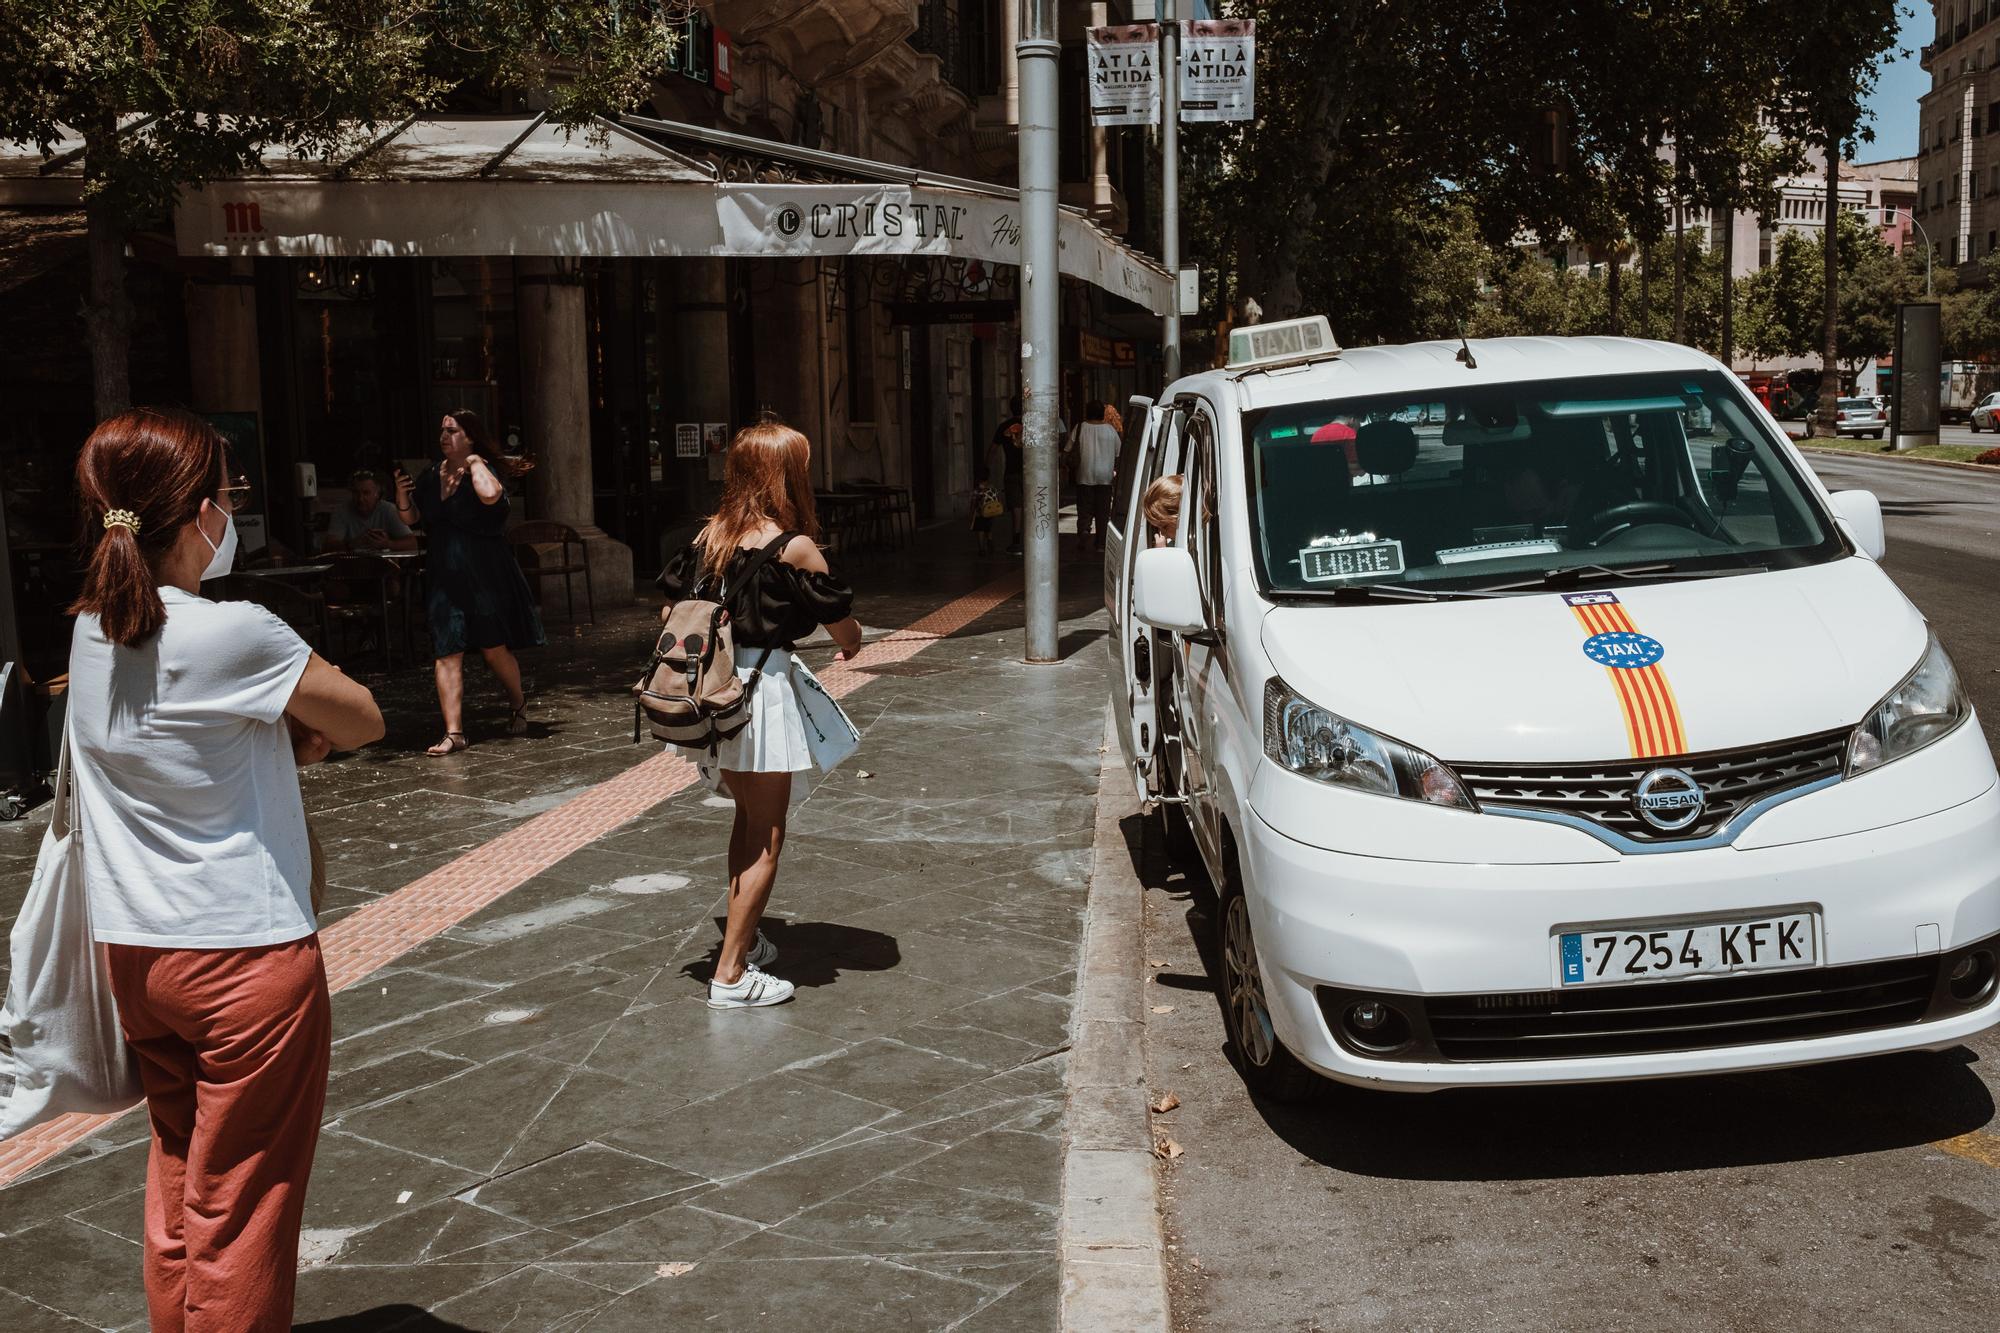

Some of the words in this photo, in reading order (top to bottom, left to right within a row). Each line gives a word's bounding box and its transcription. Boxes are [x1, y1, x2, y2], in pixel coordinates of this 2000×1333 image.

[1096, 70, 1153, 84] NTIDA
[1188, 64, 1247, 78] NTIDA
[1253, 326, 1300, 358] TAXI
[1314, 548, 1390, 576] LIBRE
[1601, 642, 1644, 656] TAXI
[1642, 794, 1700, 807] NISSAN
[1594, 930, 1703, 976] 7254
[1720, 920, 1802, 966] KFK
[1568, 963, 1579, 975] E
